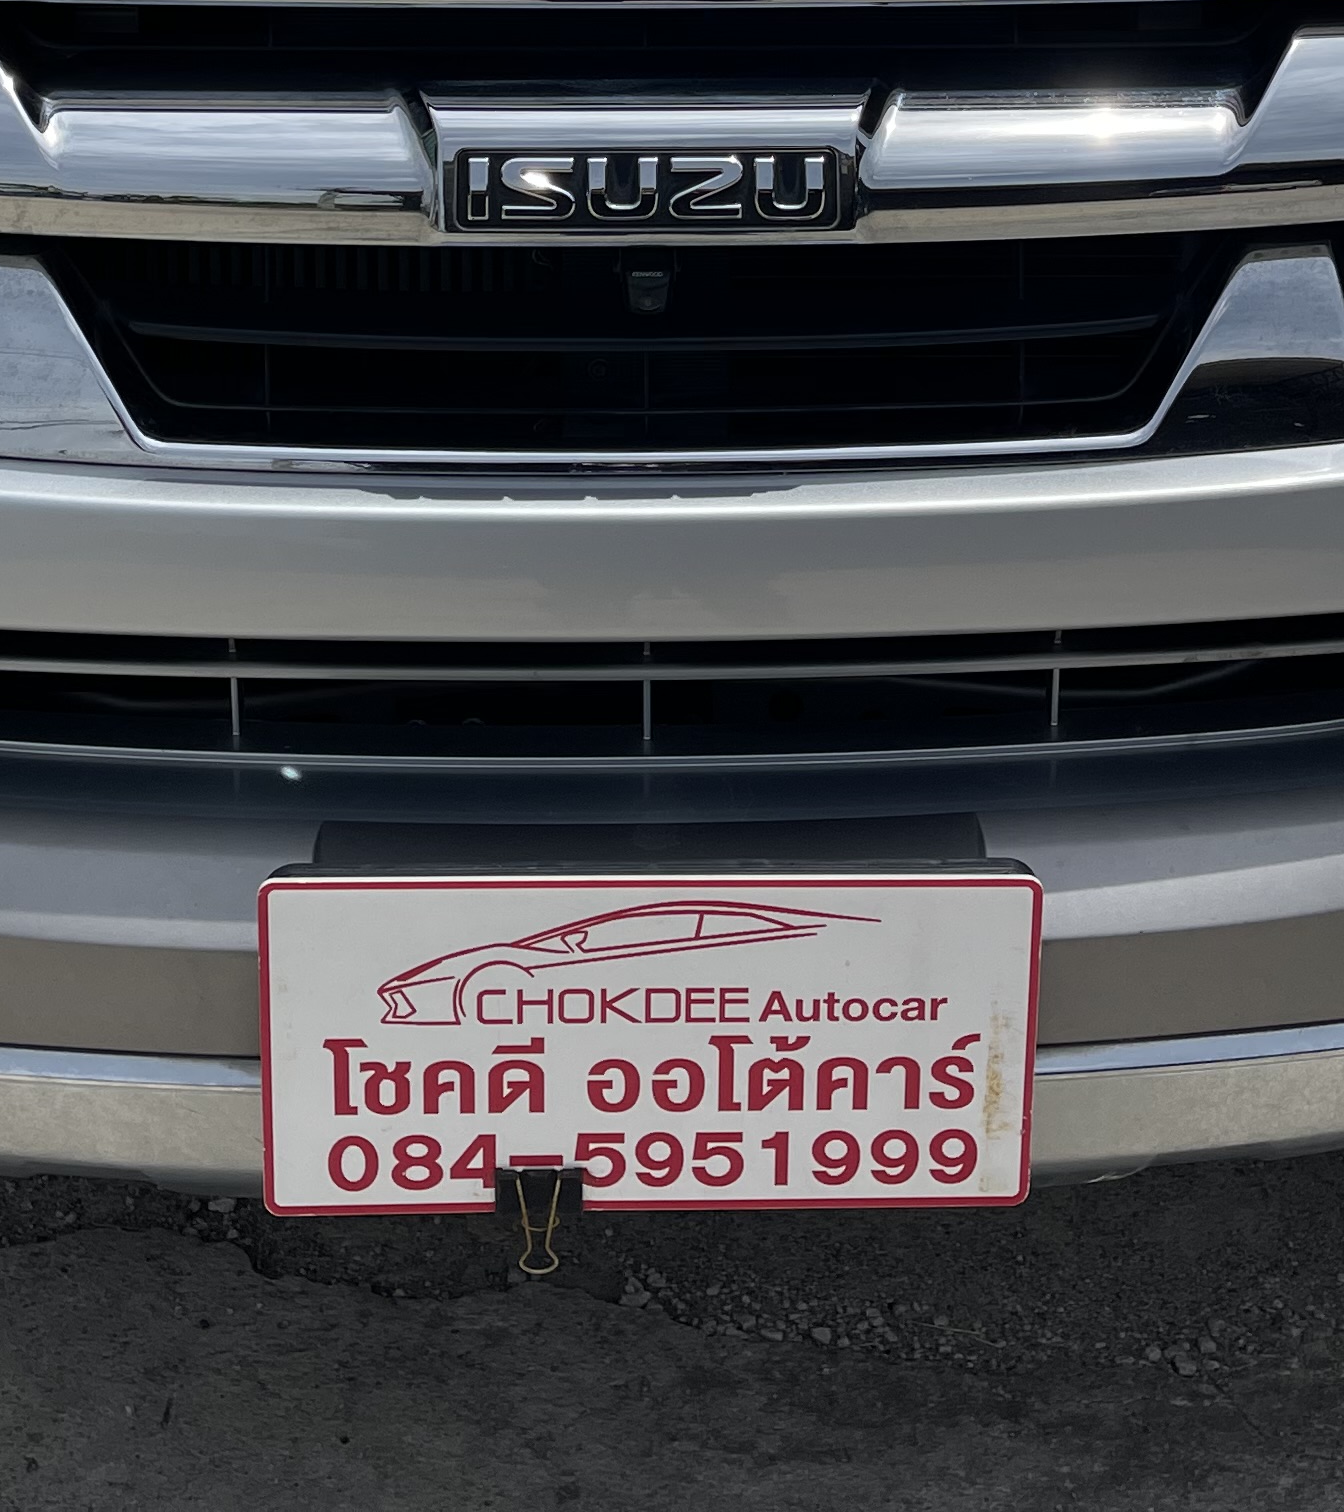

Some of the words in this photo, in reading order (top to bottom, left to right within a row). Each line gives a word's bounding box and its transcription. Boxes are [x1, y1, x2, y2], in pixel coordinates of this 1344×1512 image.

[466, 156, 825, 220] ISUZU
[476, 987, 750, 1025] CHOKDEE
[759, 990, 948, 1022] Autocar
[323, 1037, 546, 1116] โชคดี
[587, 1033, 981, 1114] ออโต้คาร์
[327, 1128, 979, 1192] 084-5951999
